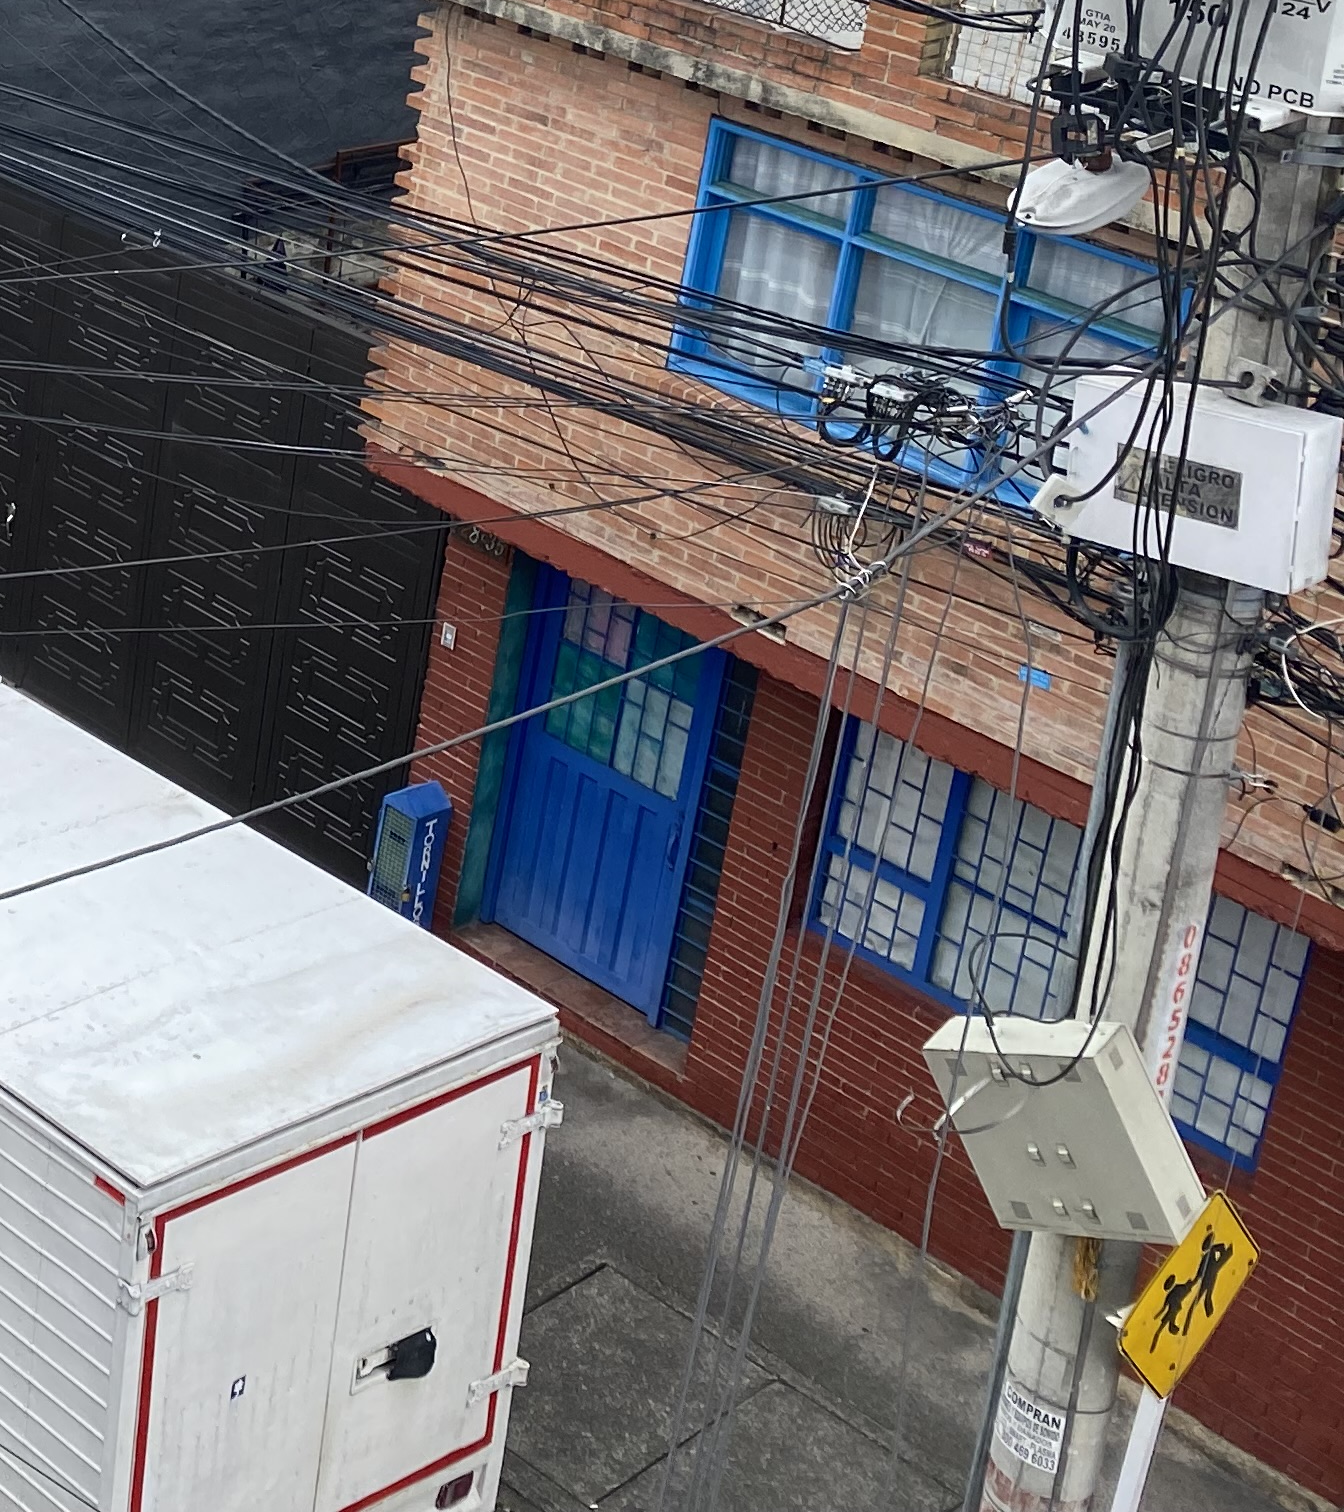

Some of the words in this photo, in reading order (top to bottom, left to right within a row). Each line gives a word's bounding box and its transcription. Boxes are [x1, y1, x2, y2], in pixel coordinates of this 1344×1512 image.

[1079, 17, 1102, 31] MAY
[1102, 22, 1116, 35] 20
[1085, 8, 1112, 23] GTIA
[1231, 75, 1262, 97] NO
[1267, 83, 1315, 109] PCB
[1153, 455, 1235, 490] EIGRO
[1153, 489, 1234, 523] ENSION
[1155, 923, 1198, 1098] 086528
[1006, 1384, 1062, 1431] COMPRAN
[1031, 1452, 1056, 1472] 6033
